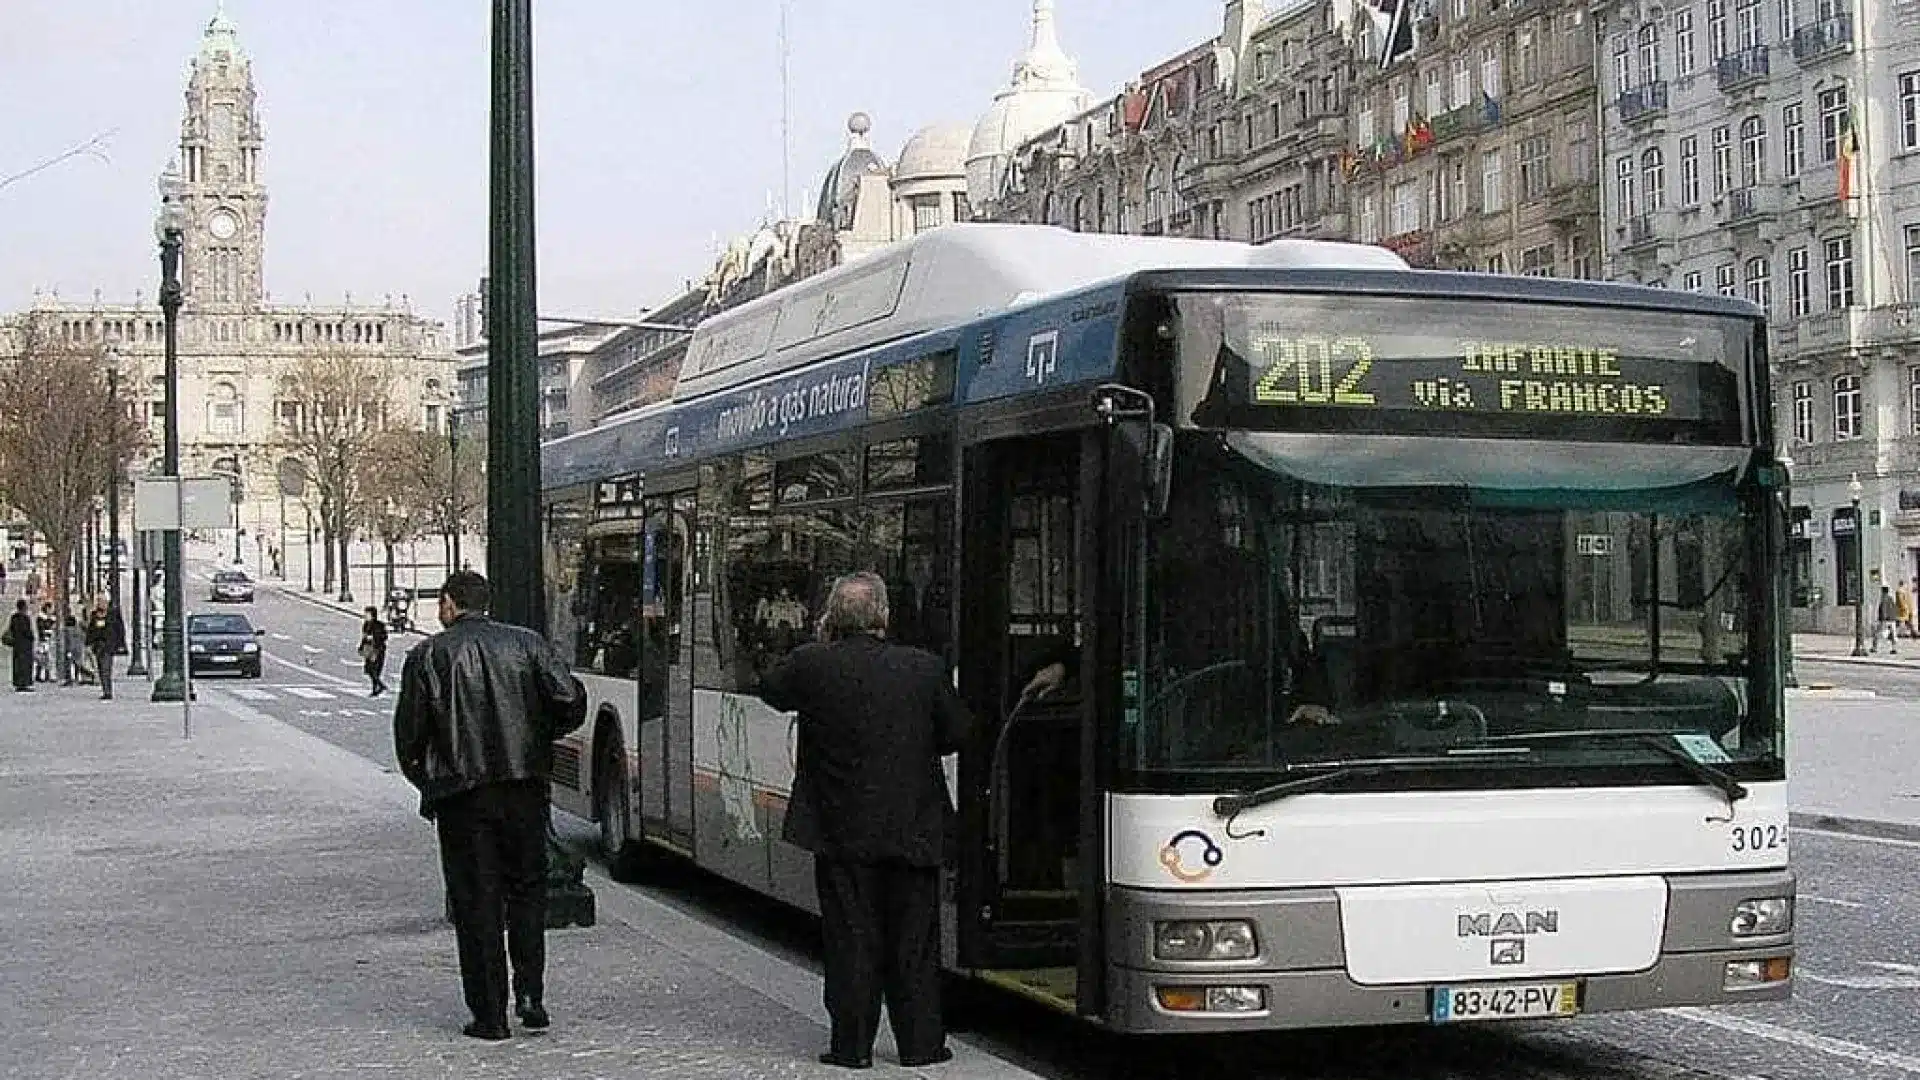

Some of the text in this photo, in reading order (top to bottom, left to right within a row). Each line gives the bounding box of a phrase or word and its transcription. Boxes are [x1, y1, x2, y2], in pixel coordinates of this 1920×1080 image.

[1254, 337, 1375, 403] 202
[1462, 344, 1621, 376] INFANTE
[768, 396, 778, 427] a
[779, 380, 807, 436] gás
[809, 357, 871, 419] natural
[1413, 376, 1667, 413] via FRANCOS
[1458, 911, 1558, 936] MAN
